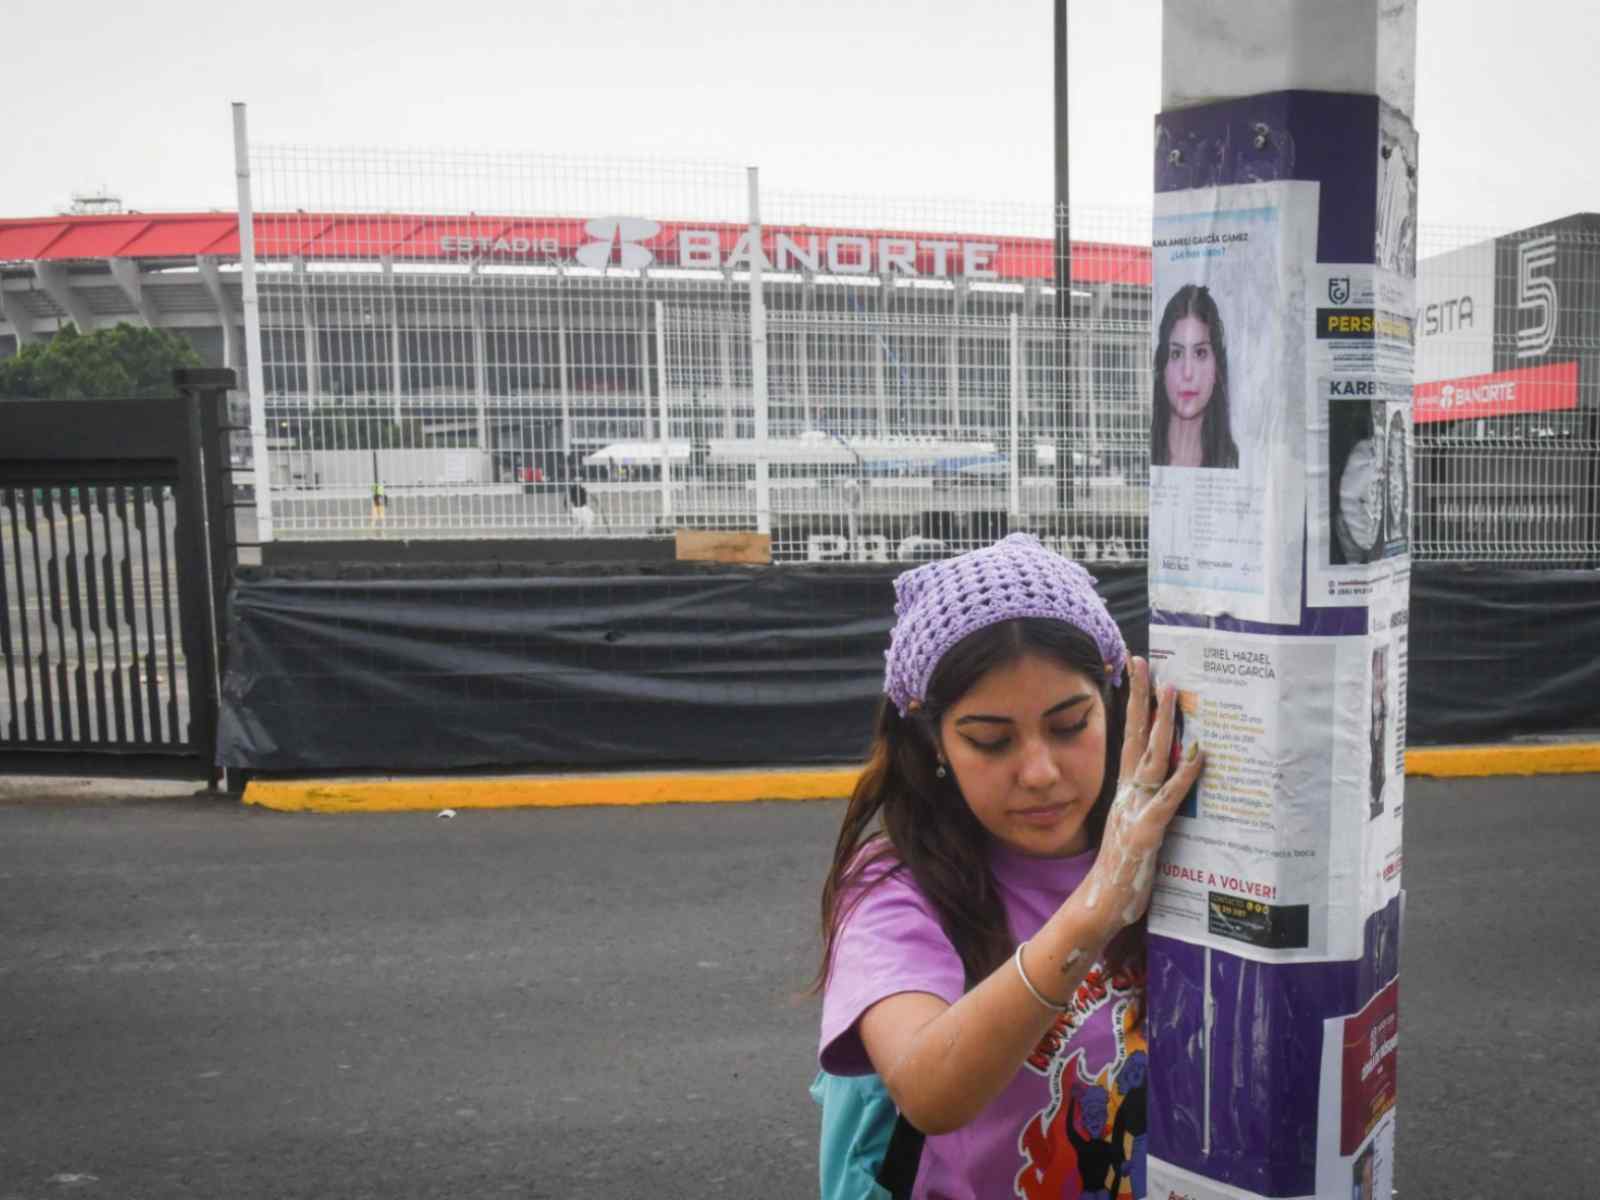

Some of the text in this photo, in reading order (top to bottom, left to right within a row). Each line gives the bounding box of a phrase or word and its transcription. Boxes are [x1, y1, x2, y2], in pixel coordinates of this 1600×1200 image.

[440, 230, 998, 278] ESTADIO BANORTE
[1517, 235, 1558, 359] 5
[1456, 382, 1517, 407] BANORTE
[1203, 647, 1271, 666] URIEL HAZAEL
[1203, 660, 1237, 675] BRAVO
[1207, 872, 1218, 888] A
[1220, 874, 1277, 900] VOLVER!
